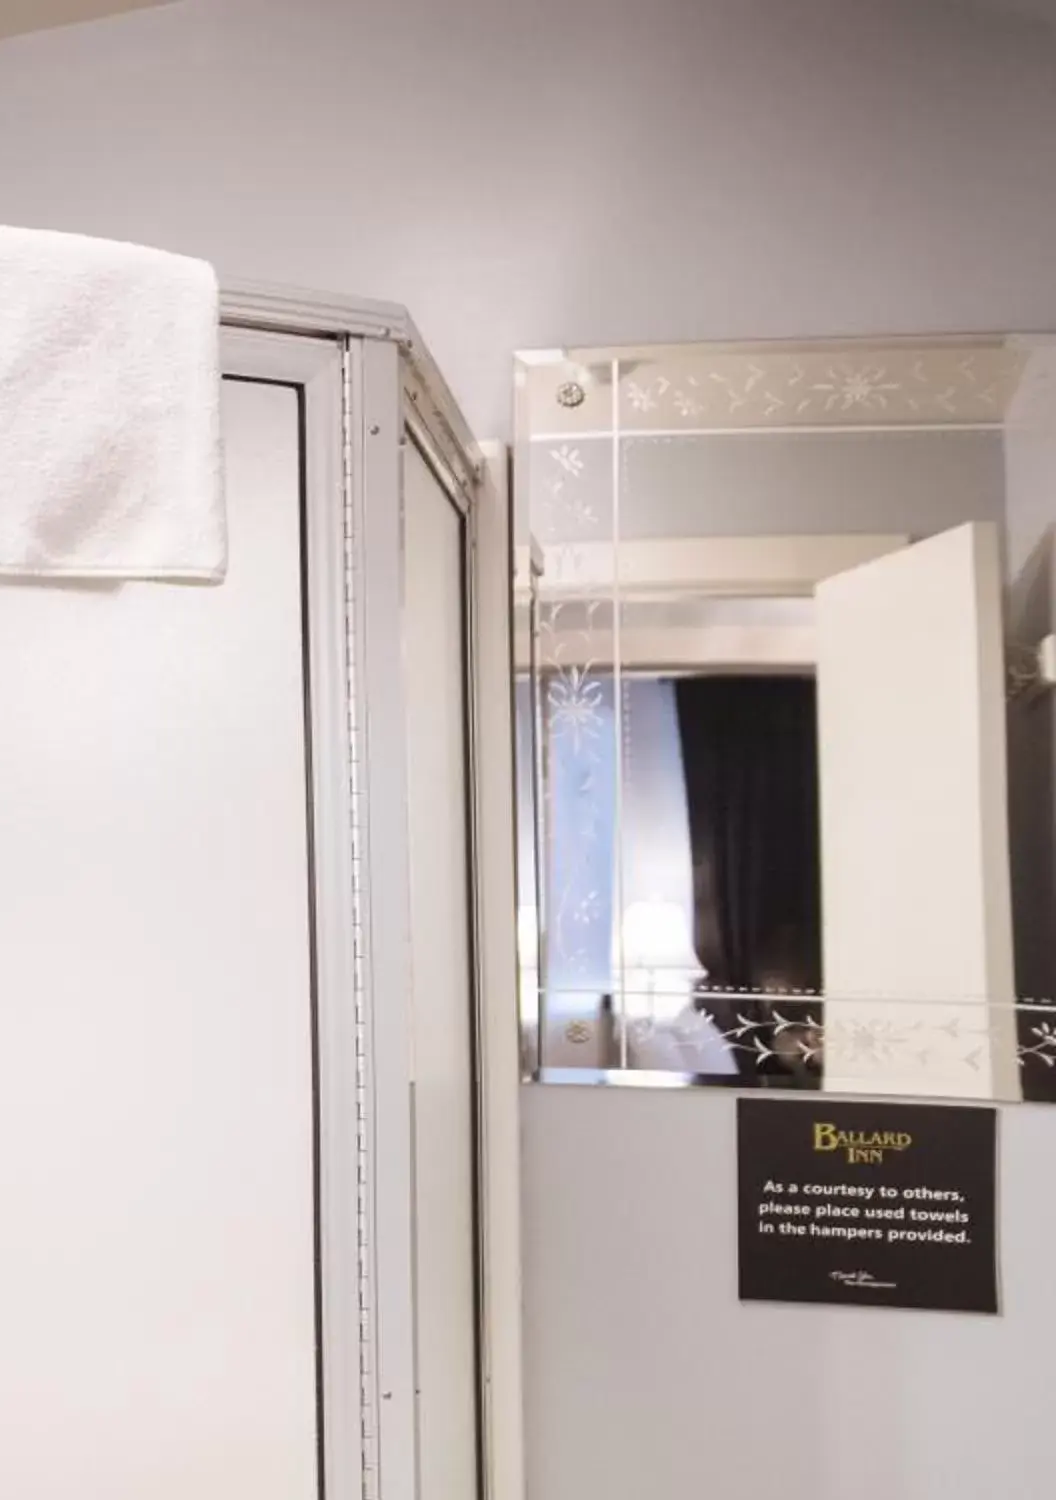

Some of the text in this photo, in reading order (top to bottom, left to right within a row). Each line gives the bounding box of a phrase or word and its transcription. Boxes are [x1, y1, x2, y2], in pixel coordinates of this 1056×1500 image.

[764, 1180, 783, 1193] As
[788, 1183, 798, 1193] a
[803, 1184, 874, 1199] courtesy
[879, 1186, 898, 1198] to
[759, 1201, 969, 1223] please place used towels
[779, 1221, 806, 1235] the
[810, 1223, 883, 1239] hampers
[887, 1229, 972, 1243] provided.
